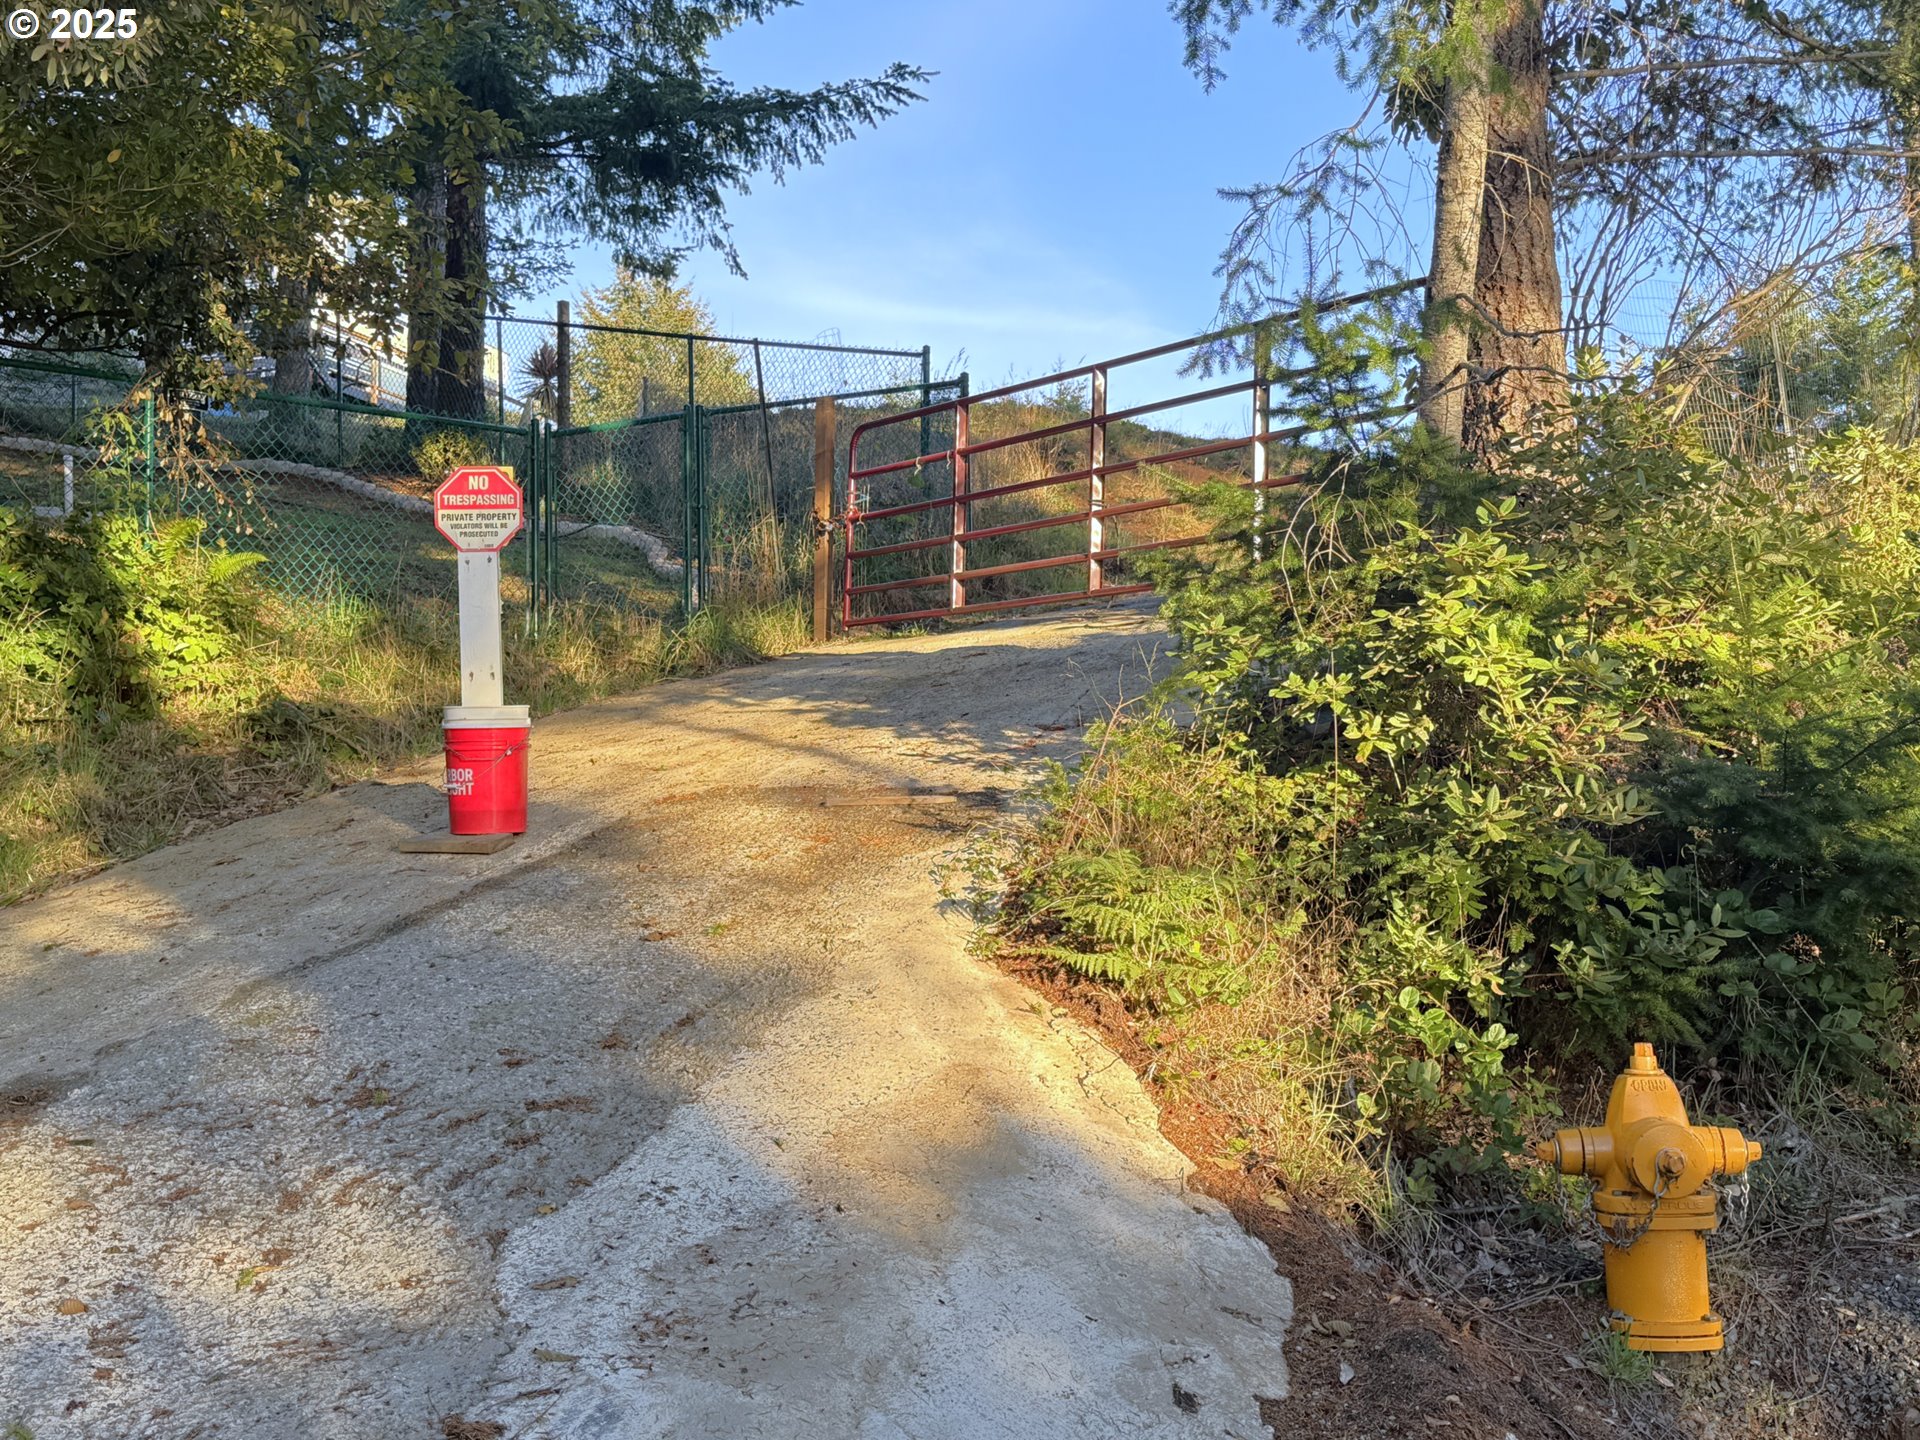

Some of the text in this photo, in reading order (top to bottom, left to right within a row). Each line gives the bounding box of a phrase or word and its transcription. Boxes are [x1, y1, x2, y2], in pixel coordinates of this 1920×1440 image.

[468, 475, 489, 490] NO
[442, 494, 515, 506] TRESPASSING
[441, 512, 517, 522] PRIVATE PROPERTY
[450, 522, 483, 530] VIOLATORS
[459, 530, 499, 538] PROSECUTED
[1622, 1199, 1705, 1211] WAEROUS
